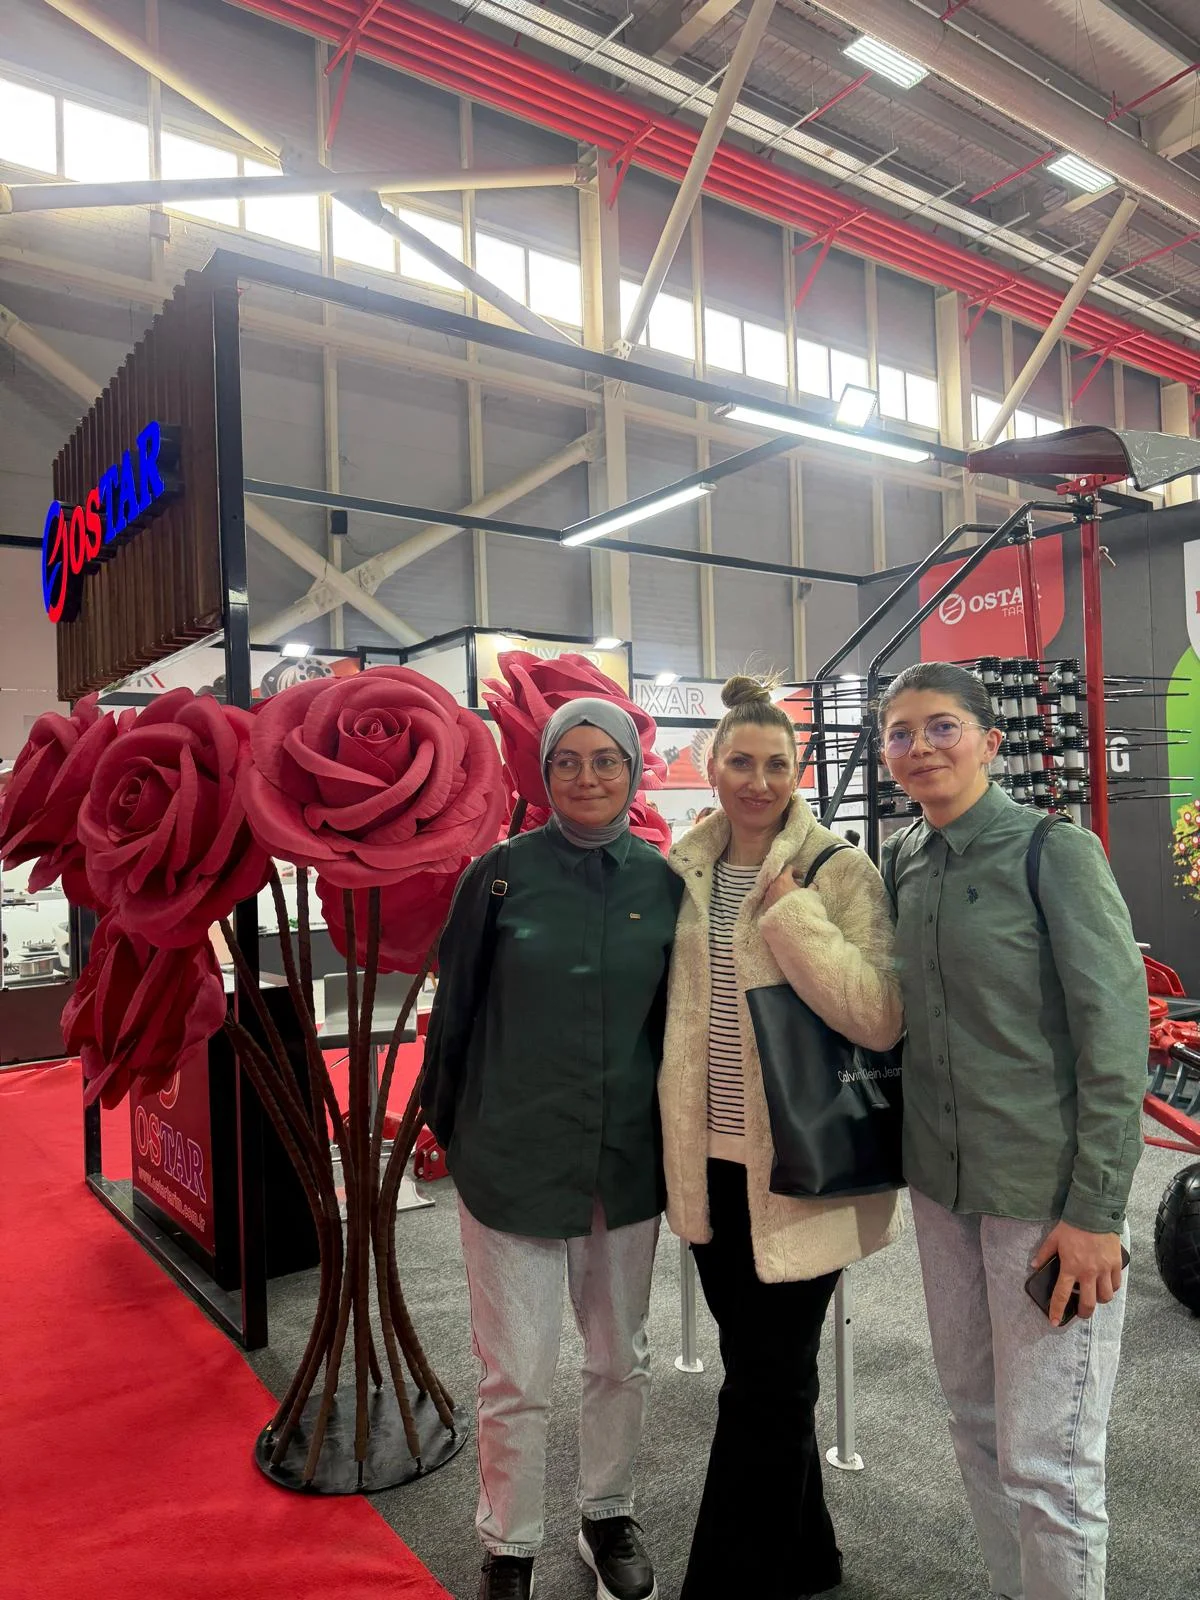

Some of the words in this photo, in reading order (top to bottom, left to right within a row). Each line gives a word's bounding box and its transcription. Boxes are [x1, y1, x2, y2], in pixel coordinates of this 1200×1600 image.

[69, 420, 165, 575] OSTAR
[969, 584, 1042, 613] OSTA
[837, 1069, 861, 1083] Calvin
[135, 1105, 206, 1204] OSTAR
